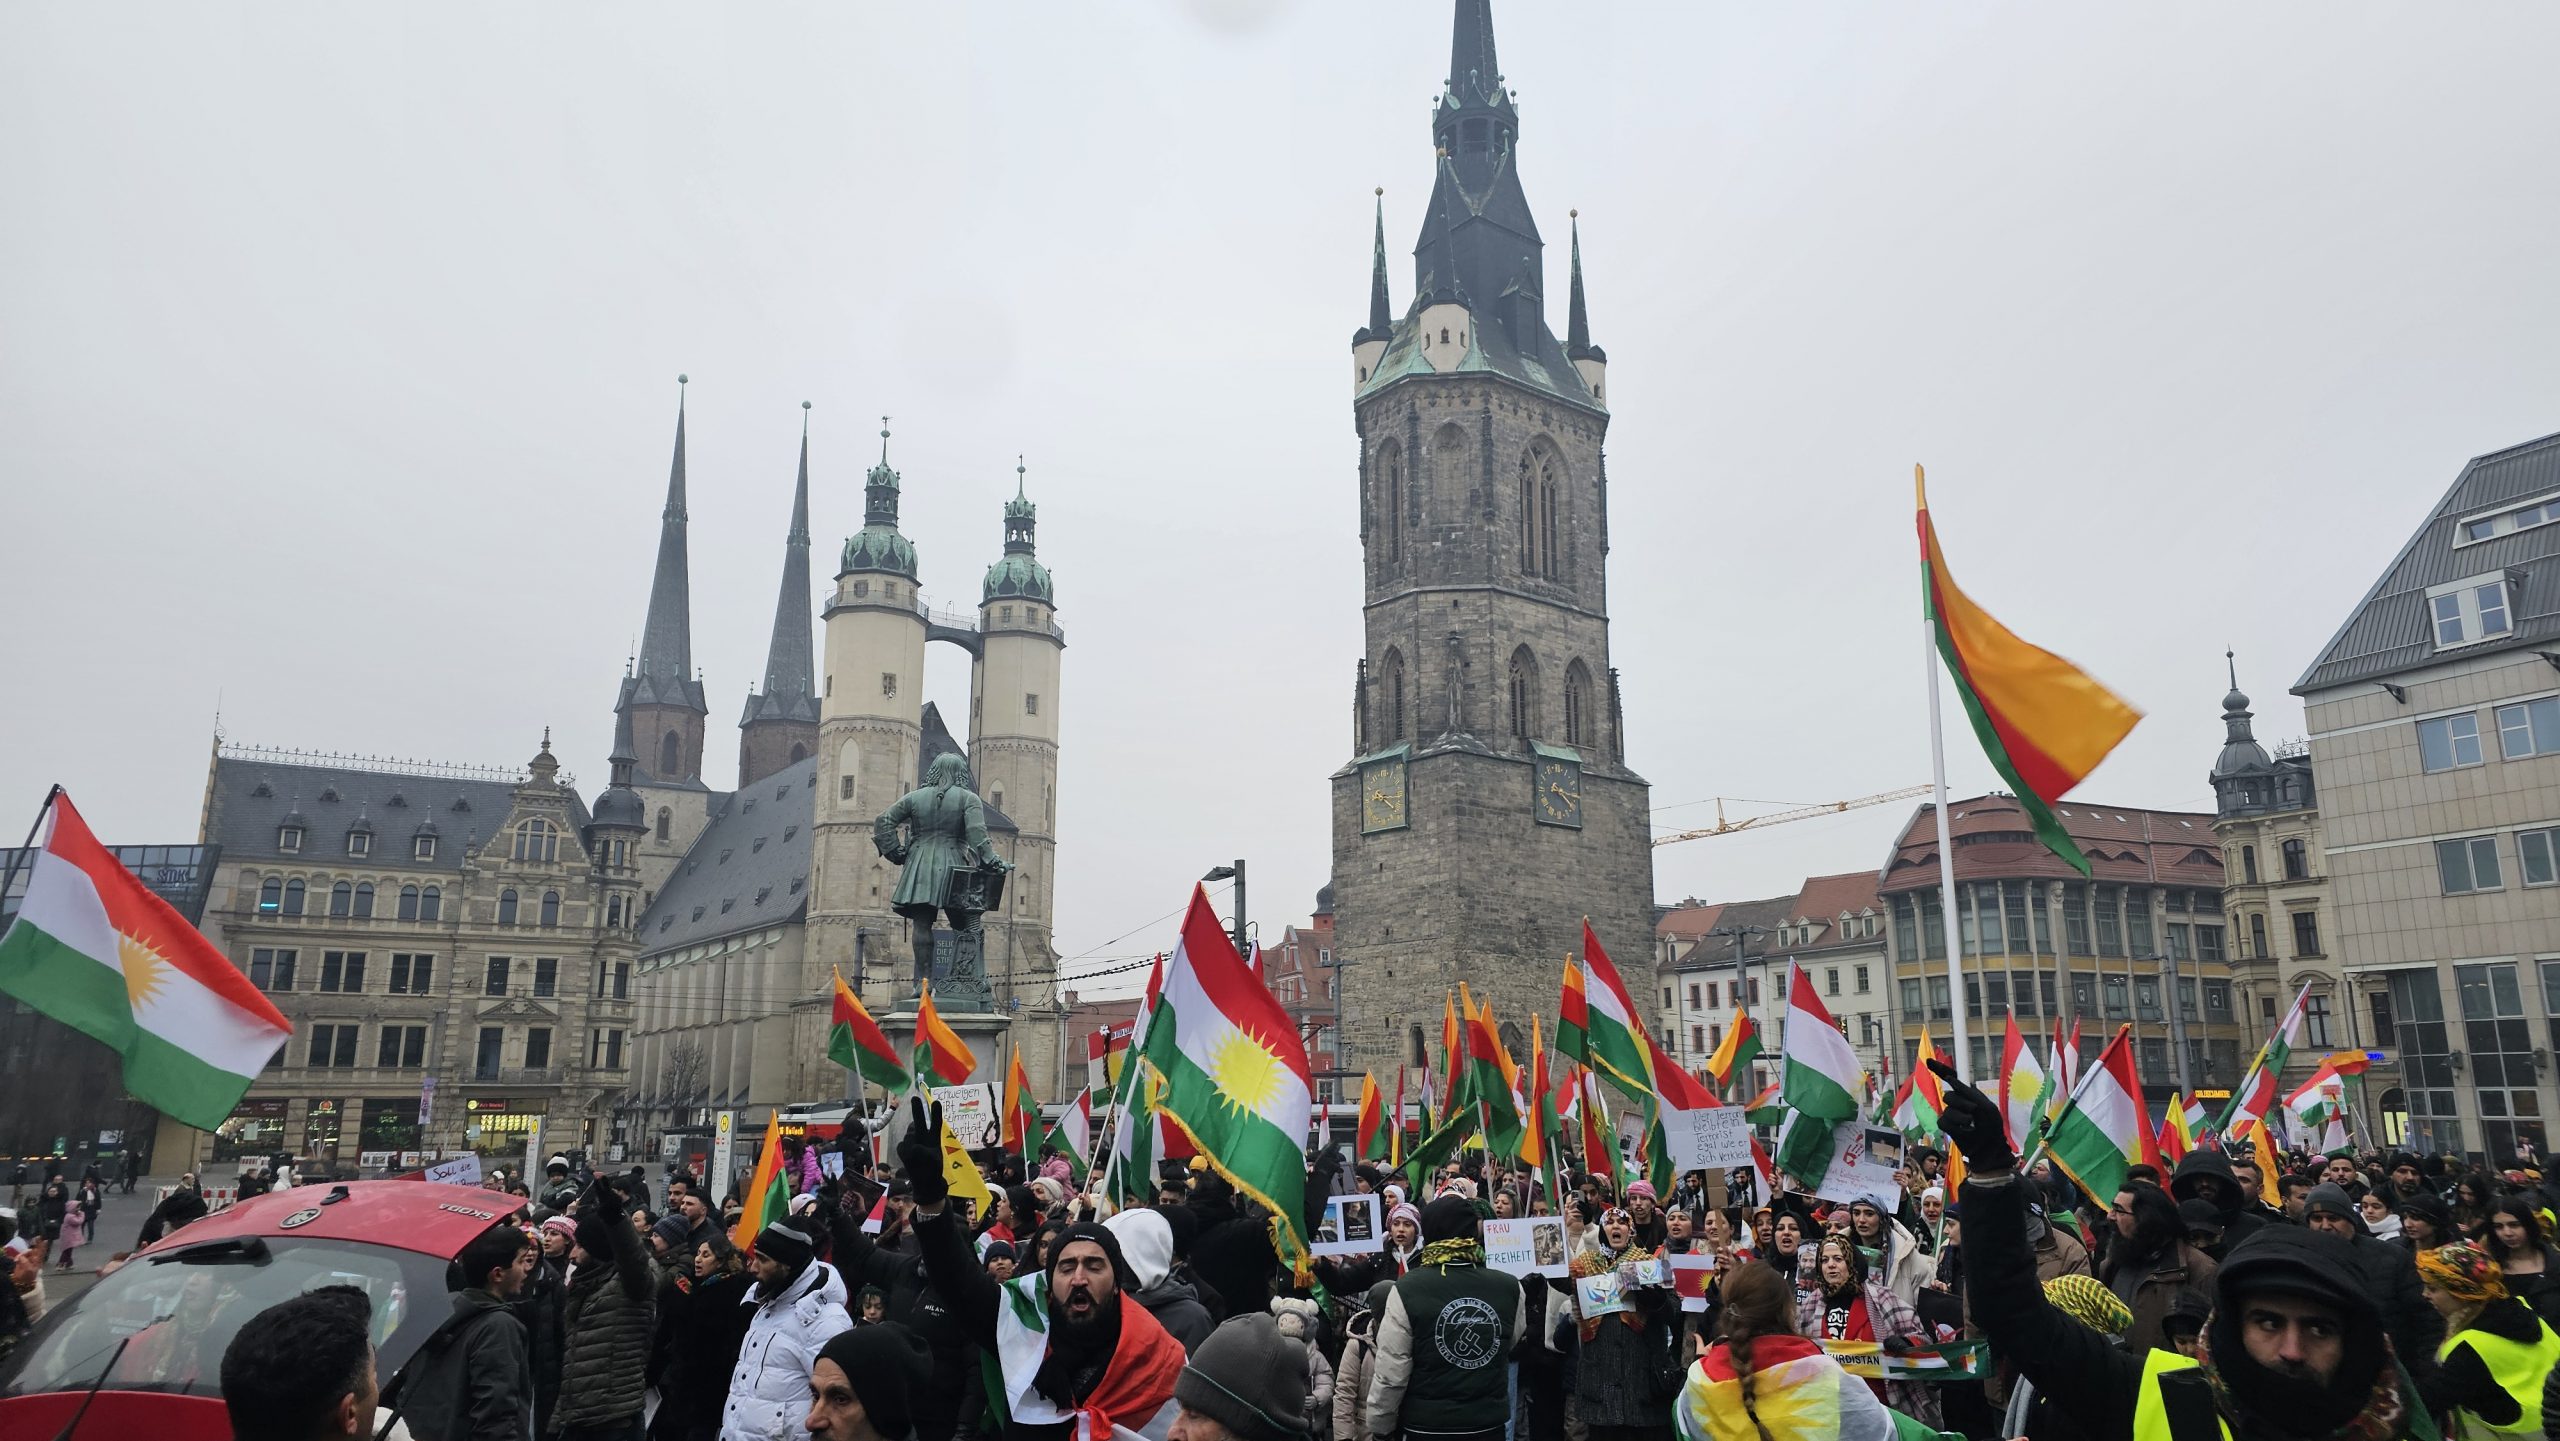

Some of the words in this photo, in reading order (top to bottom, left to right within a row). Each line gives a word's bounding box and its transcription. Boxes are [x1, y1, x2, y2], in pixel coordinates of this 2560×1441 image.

[933, 1088, 980, 1101] Schweigen
[943, 1100, 956, 1113] ißt
[944, 1112, 987, 1123] stimmung
[1697, 1141, 1717, 1152] egal
[433, 1166, 456, 1180] Soll
[460, 1163, 471, 1172] die
[1487, 1223, 1510, 1235] FRAU
[1487, 1250, 1532, 1264] FREIHEIT
